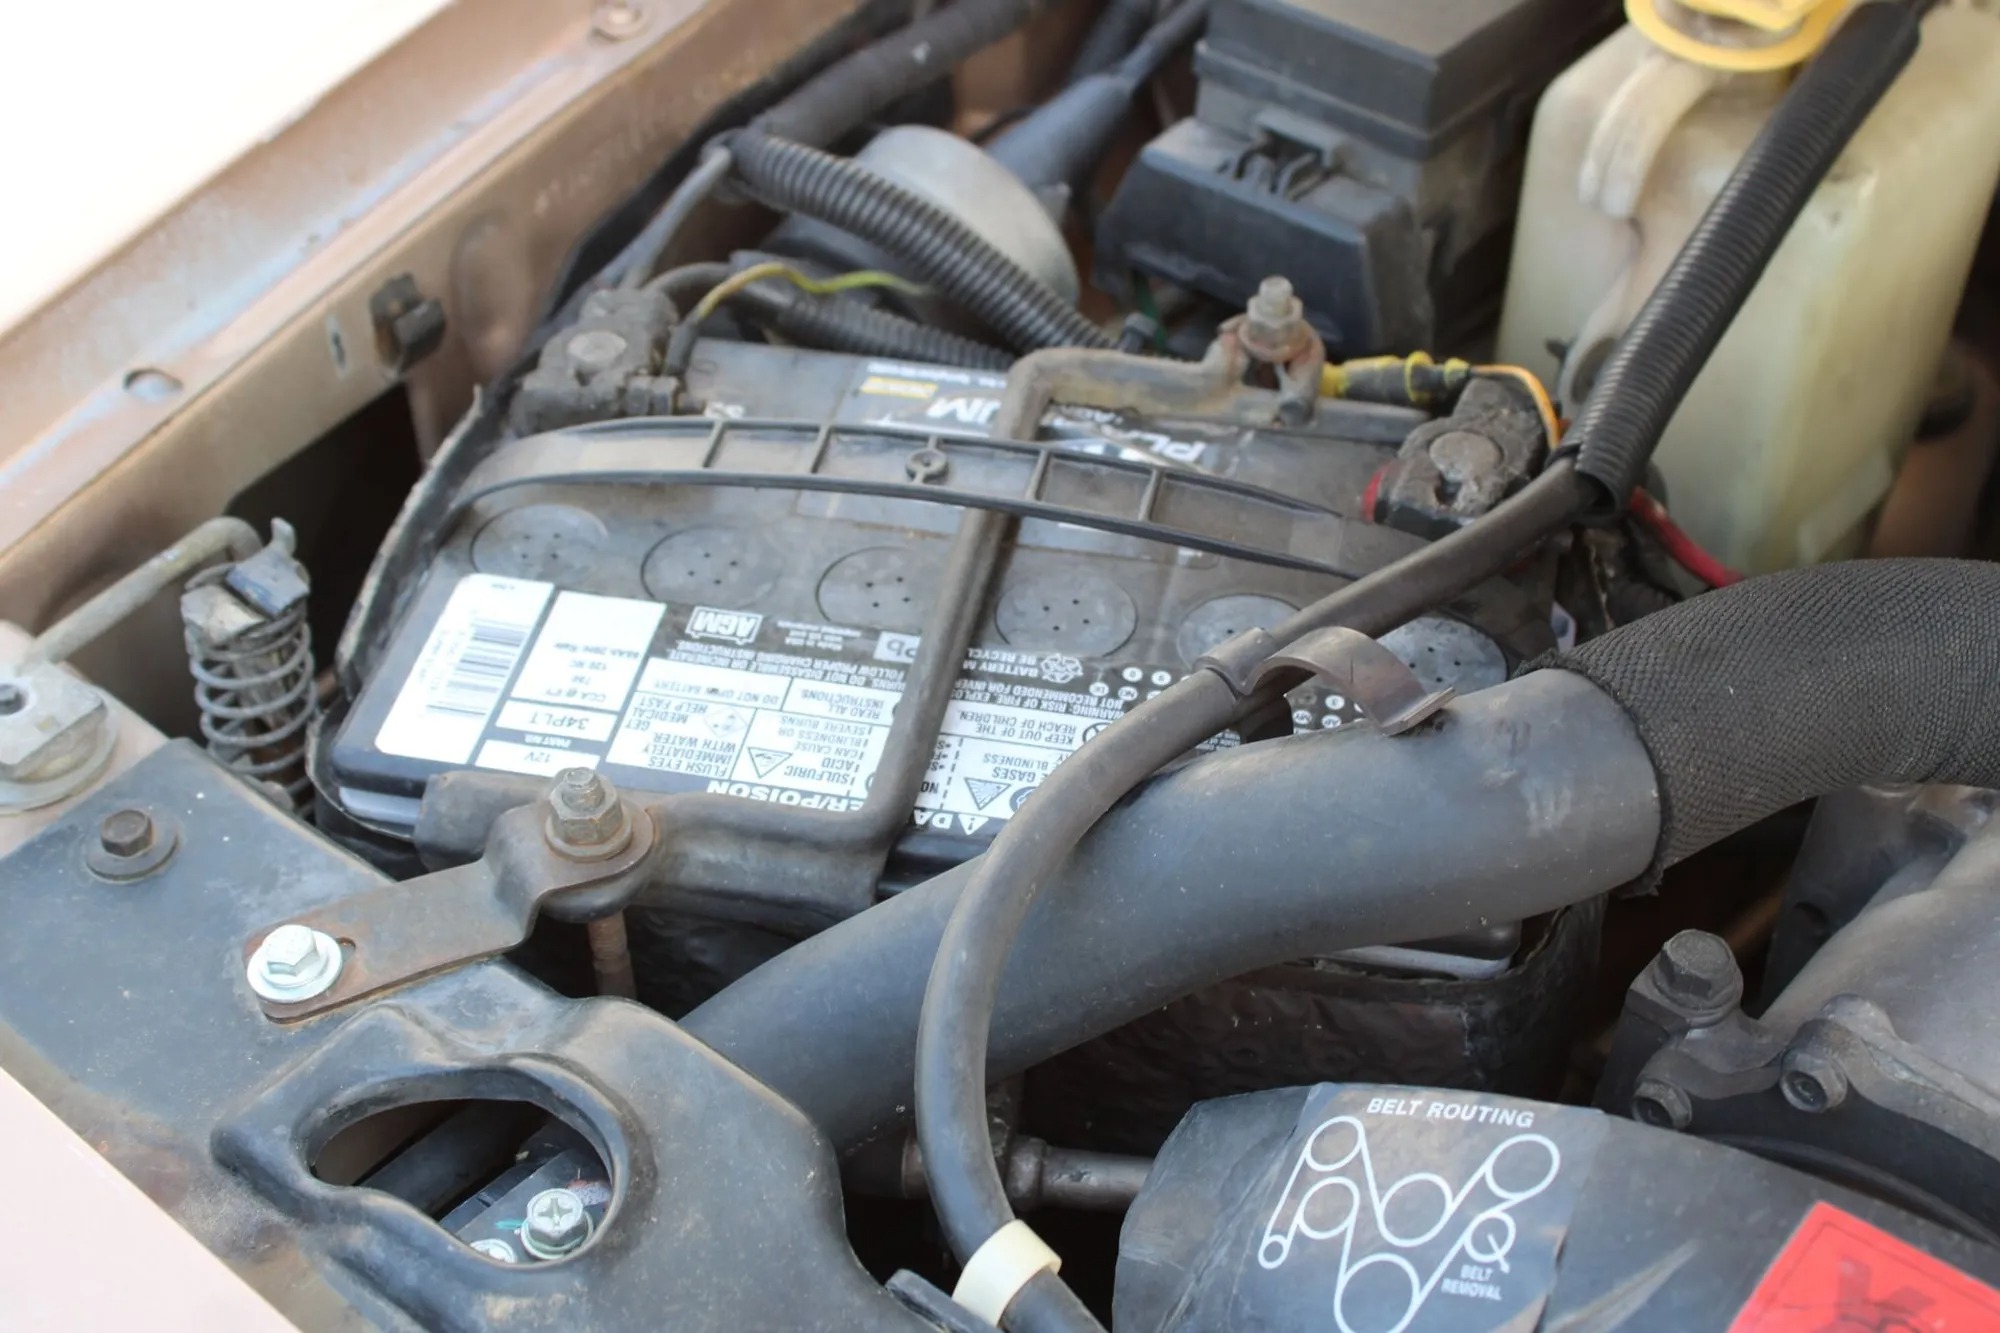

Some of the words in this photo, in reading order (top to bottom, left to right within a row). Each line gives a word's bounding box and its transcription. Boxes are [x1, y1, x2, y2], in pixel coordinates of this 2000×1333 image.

[693, 610, 757, 638] AGM
[814, 658, 858, 674] PROPER
[979, 660, 1039, 677] BATTERY
[826, 672, 848, 684] NOT
[848, 674, 866, 686] DO
[654, 680, 702, 696] BATTERY
[988, 681, 1011, 694] FOR
[1013, 683, 1098, 706] RECOMMENDED
[639, 696, 672, 710] FAST
[736, 692, 760, 704] NOT
[764, 694, 779, 706] DO
[1023, 698, 1038, 710] OF
[1101, 697, 1123, 710] NOT
[674, 702, 708, 714] HELP
[828, 703, 848, 714] ALL
[850, 706, 880, 720] READ
[1040, 700, 1067, 714] RISK
[630, 706, 688, 724] MEDICAL
[624, 718, 650, 732] GET
[823, 720, 866, 736] SEVERE
[974, 724, 997, 736] THE
[1020, 718, 1035, 730] OF
[1038, 720, 1076, 734] REACH
[778, 726, 796, 738] OR
[798, 729, 862, 746] BLINDNESS
[1001, 727, 1016, 738] OF
[1018, 729, 1042, 742] OUT
[1044, 732, 1074, 746] KEEP
[652, 732, 698, 748] WATER
[702, 738, 736, 752] WITH
[642, 744, 732, 764] IMMEDIATELY
[794, 741, 832, 754] CAUSE
[834, 747, 858, 758] CAN
[647, 755, 682, 772] EYES
[821, 757, 854, 771] ACID
[982, 752, 1049, 771] BLINDNESS
[686, 762, 728, 778] FLUSH
[784, 764, 850, 784] SULFURIC
[992, 766, 1036, 783] GASES
[1366, 1098, 1422, 1116] BELT
[1426, 1102, 1535, 1128] ROUTING
[1460, 1264, 1494, 1282] BELT
[1441, 1278, 1503, 1301] REMOVAL
